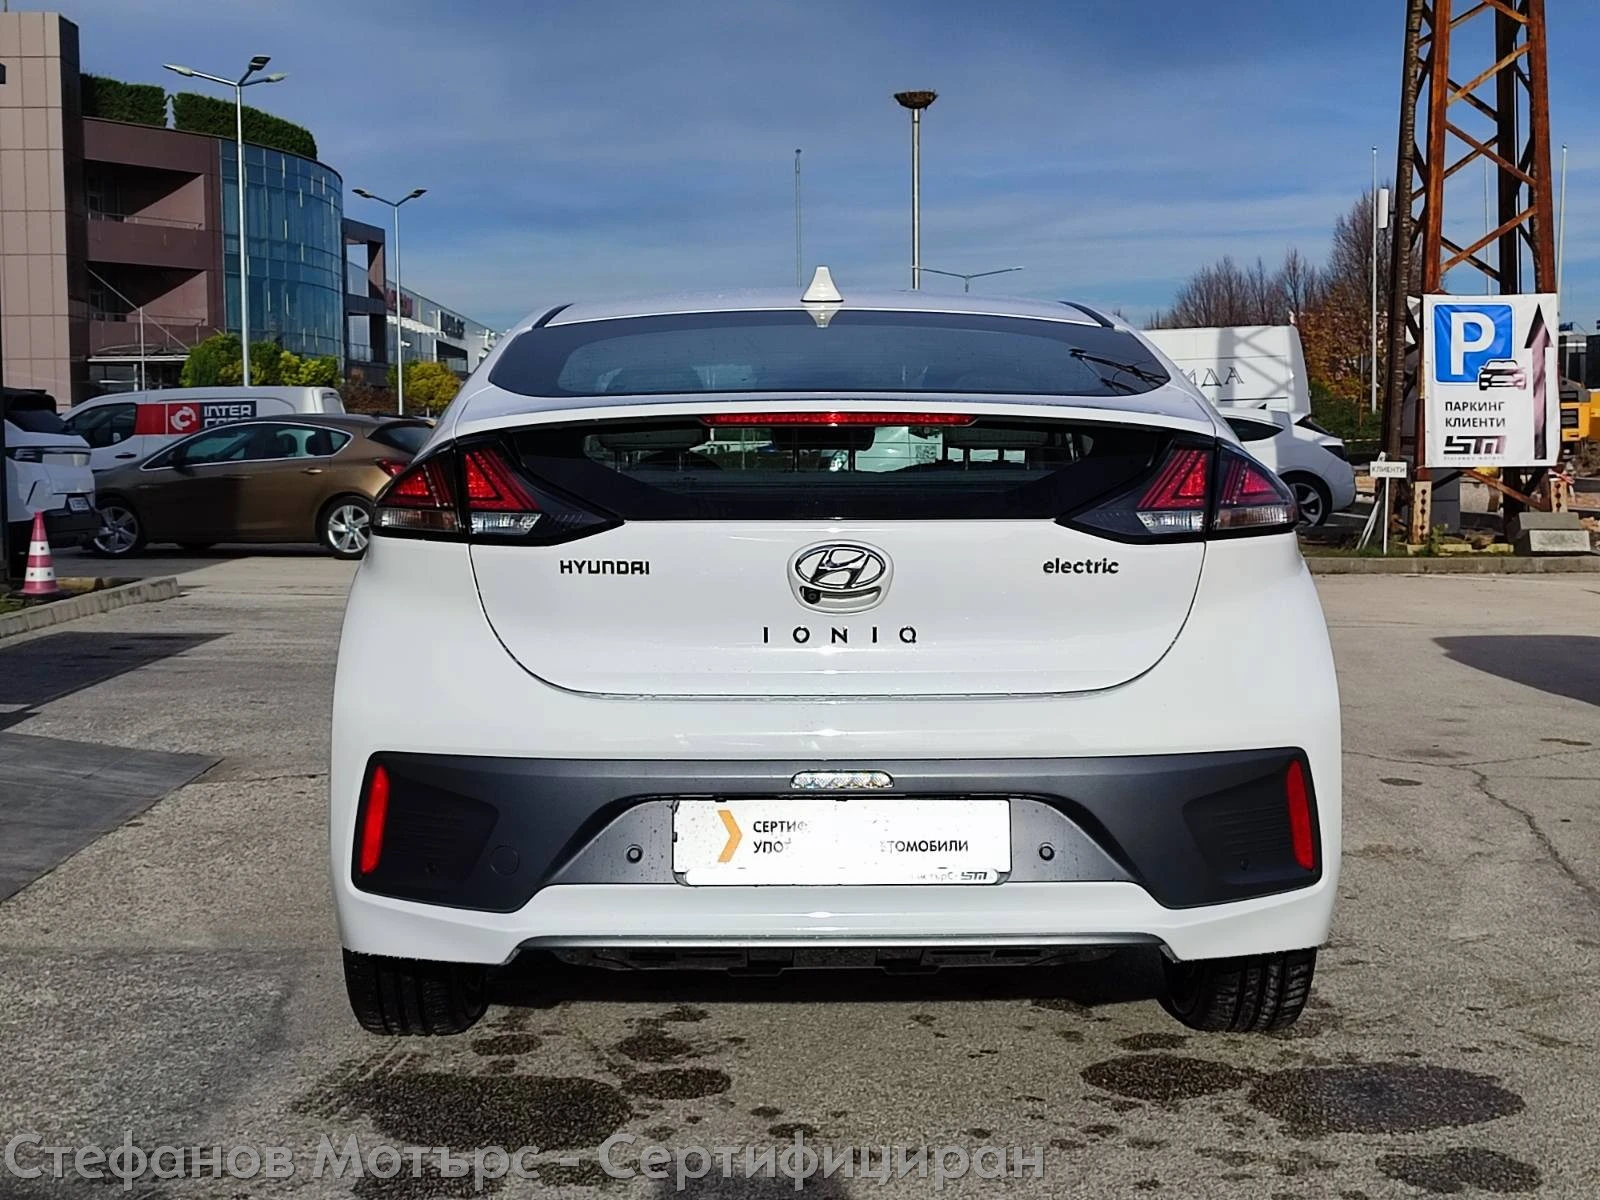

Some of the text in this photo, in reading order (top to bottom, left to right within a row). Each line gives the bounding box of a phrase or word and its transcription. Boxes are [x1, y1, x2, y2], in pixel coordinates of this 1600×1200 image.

[1450, 311, 1496, 376] P
[203, 405, 252, 418] INTER
[1445, 401, 1505, 412] ПАРКИНГ
[1445, 417, 1506, 428] КЛИЕНТИ
[560, 560, 650, 575] HYUNDAI
[1042, 557, 1120, 574] electric
[762, 626, 918, 645] IONIQ
[753, 839, 792, 854] УПО
